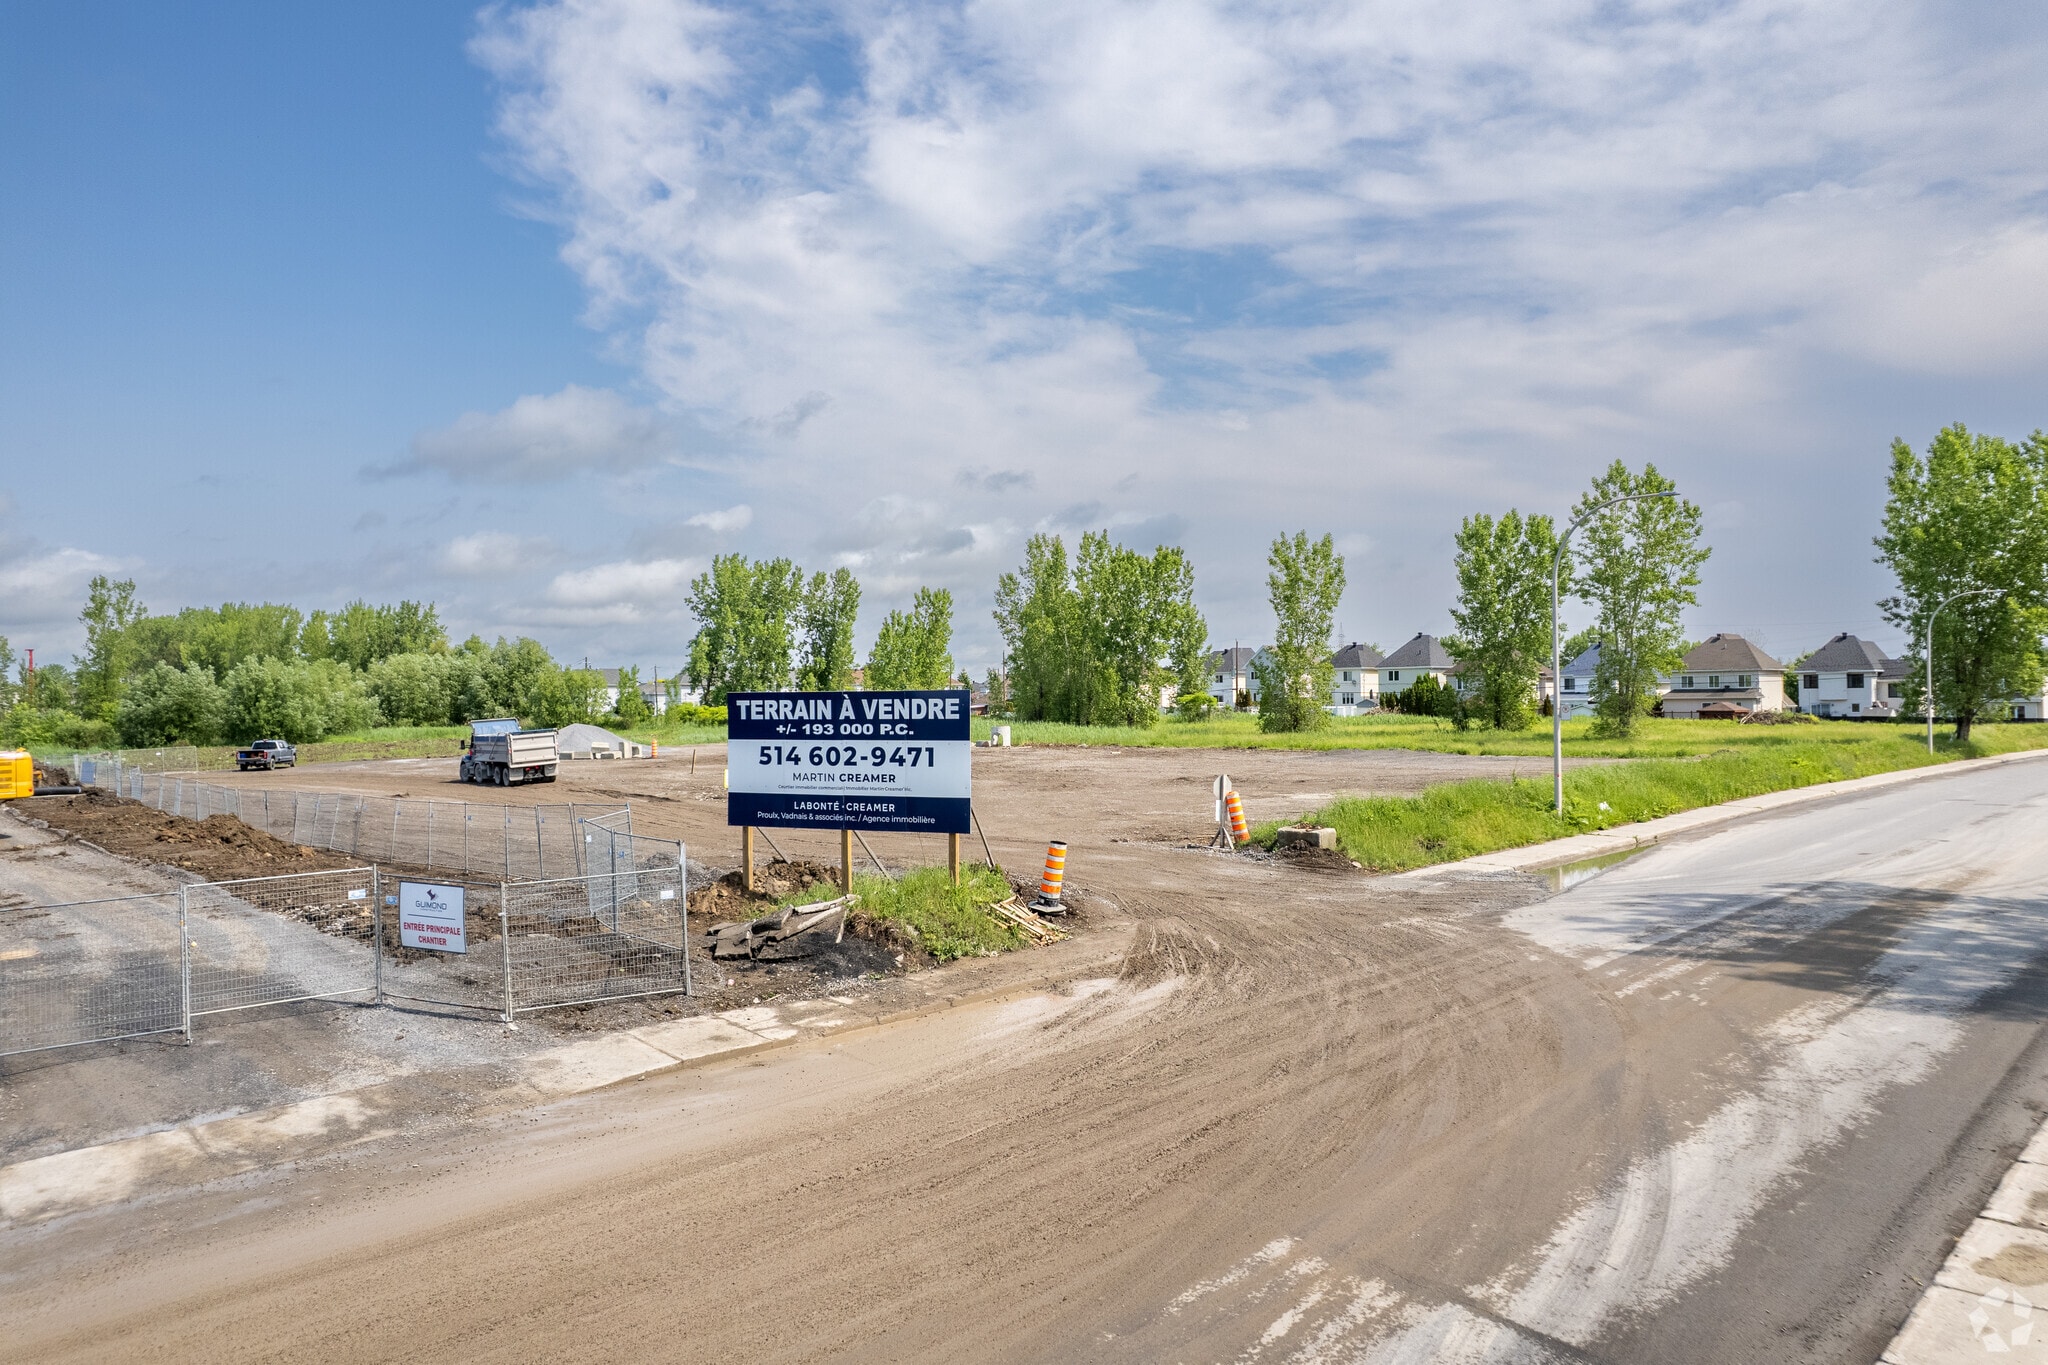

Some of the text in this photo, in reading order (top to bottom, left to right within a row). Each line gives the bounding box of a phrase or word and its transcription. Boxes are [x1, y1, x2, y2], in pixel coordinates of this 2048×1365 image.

[736, 694, 960, 720] TERRAIN À VENDRE
[802, 723, 834, 735] 193
[840, 723, 874, 735] 000
[880, 723, 914, 735] P.C.
[759, 746, 934, 768] 514 602-9471
[792, 772, 896, 783] MARTIN CREAMER
[757, 811, 780, 820] Proulx,
[781, 812, 808, 821] Vadnais
[814, 813, 843, 822] associés
[862, 815, 890, 824] Agence
[891, 815, 936, 825] immobilière
[416, 900, 447, 910] GUIMOND
[403, 922, 460, 935] ENTRÉE PRINCIPALE
[418, 936, 447, 945] CHANTIER
